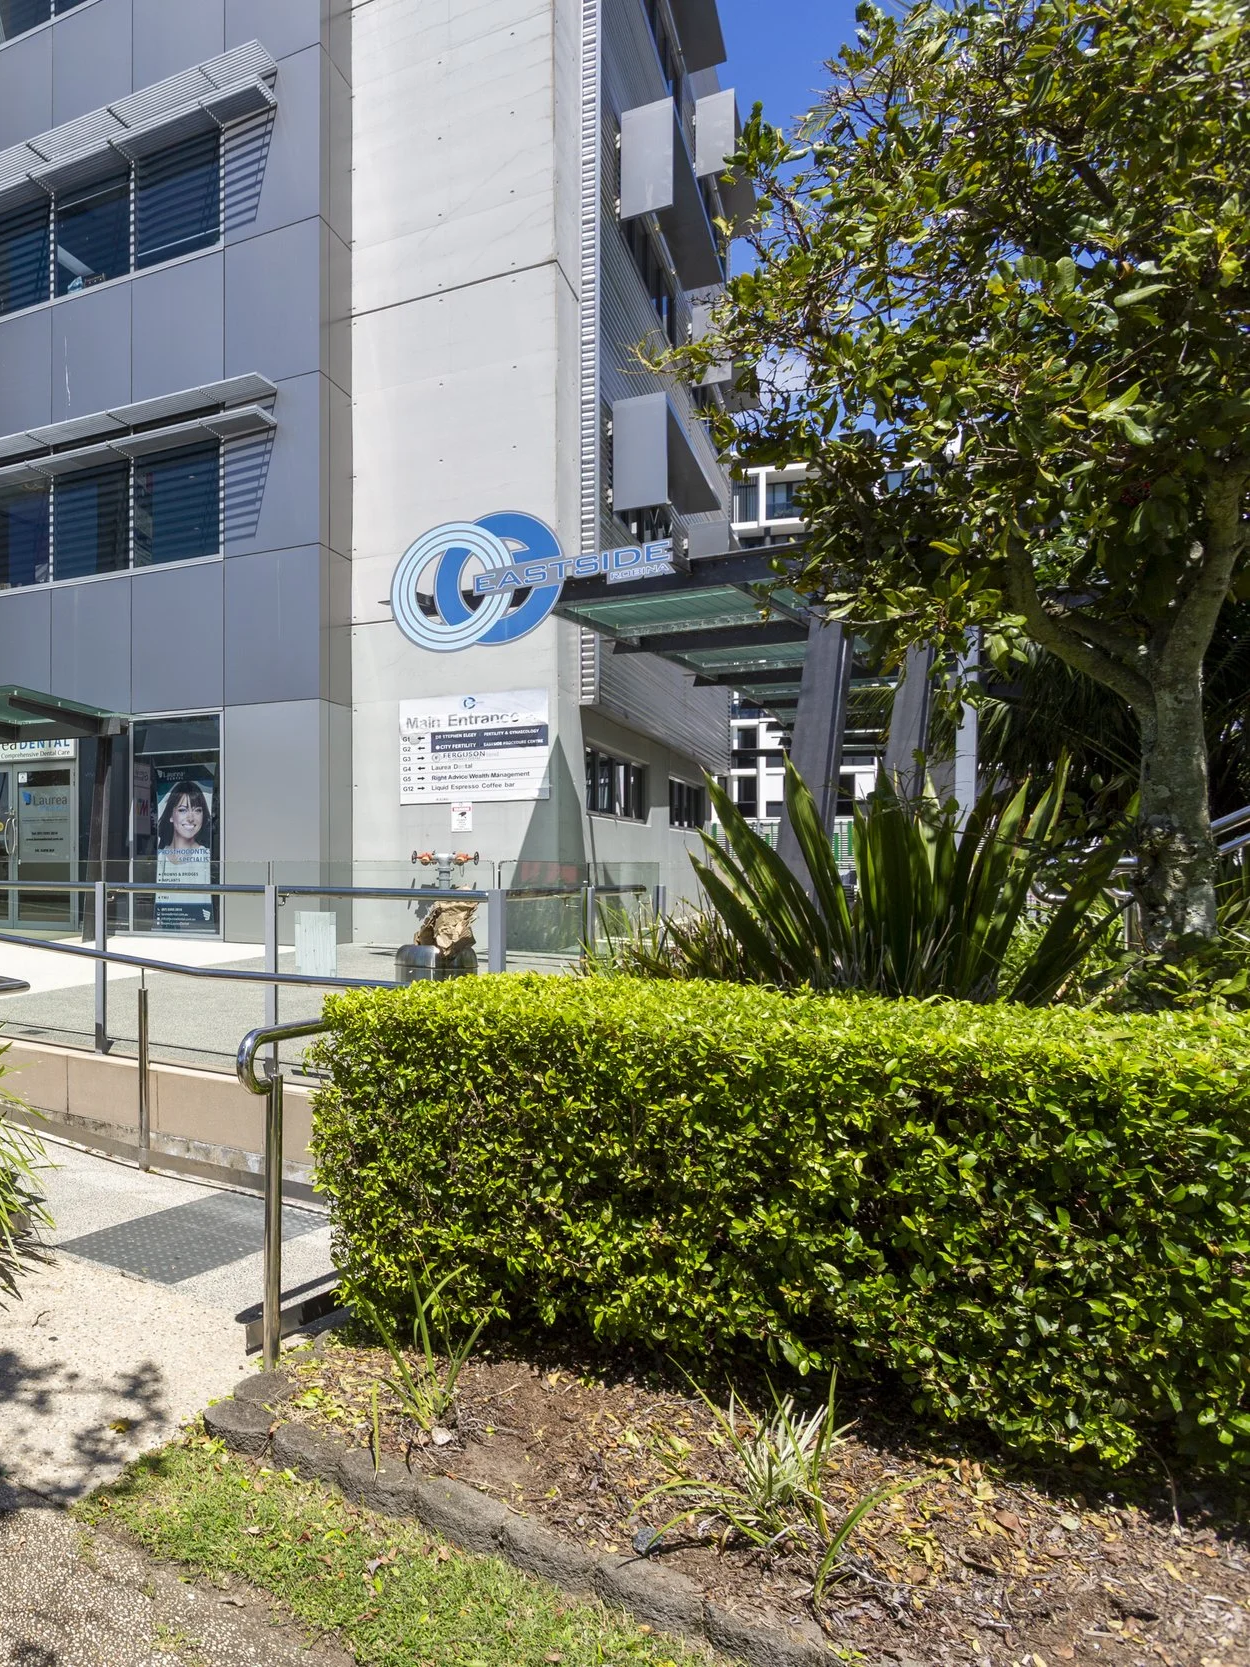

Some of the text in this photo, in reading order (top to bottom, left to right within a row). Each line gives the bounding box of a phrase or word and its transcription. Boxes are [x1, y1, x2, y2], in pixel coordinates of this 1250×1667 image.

[475, 540, 673, 595] EASTSIDE
[609, 562, 671, 581] ROBINA
[406, 715, 441, 729] Main
[1, 751, 39, 760] Comprehensive
[442, 750, 486, 759] FERGUSON
[490, 771, 530, 779] Management
[431, 784, 449, 792] Liquid
[33, 795, 68, 806] Laurea
